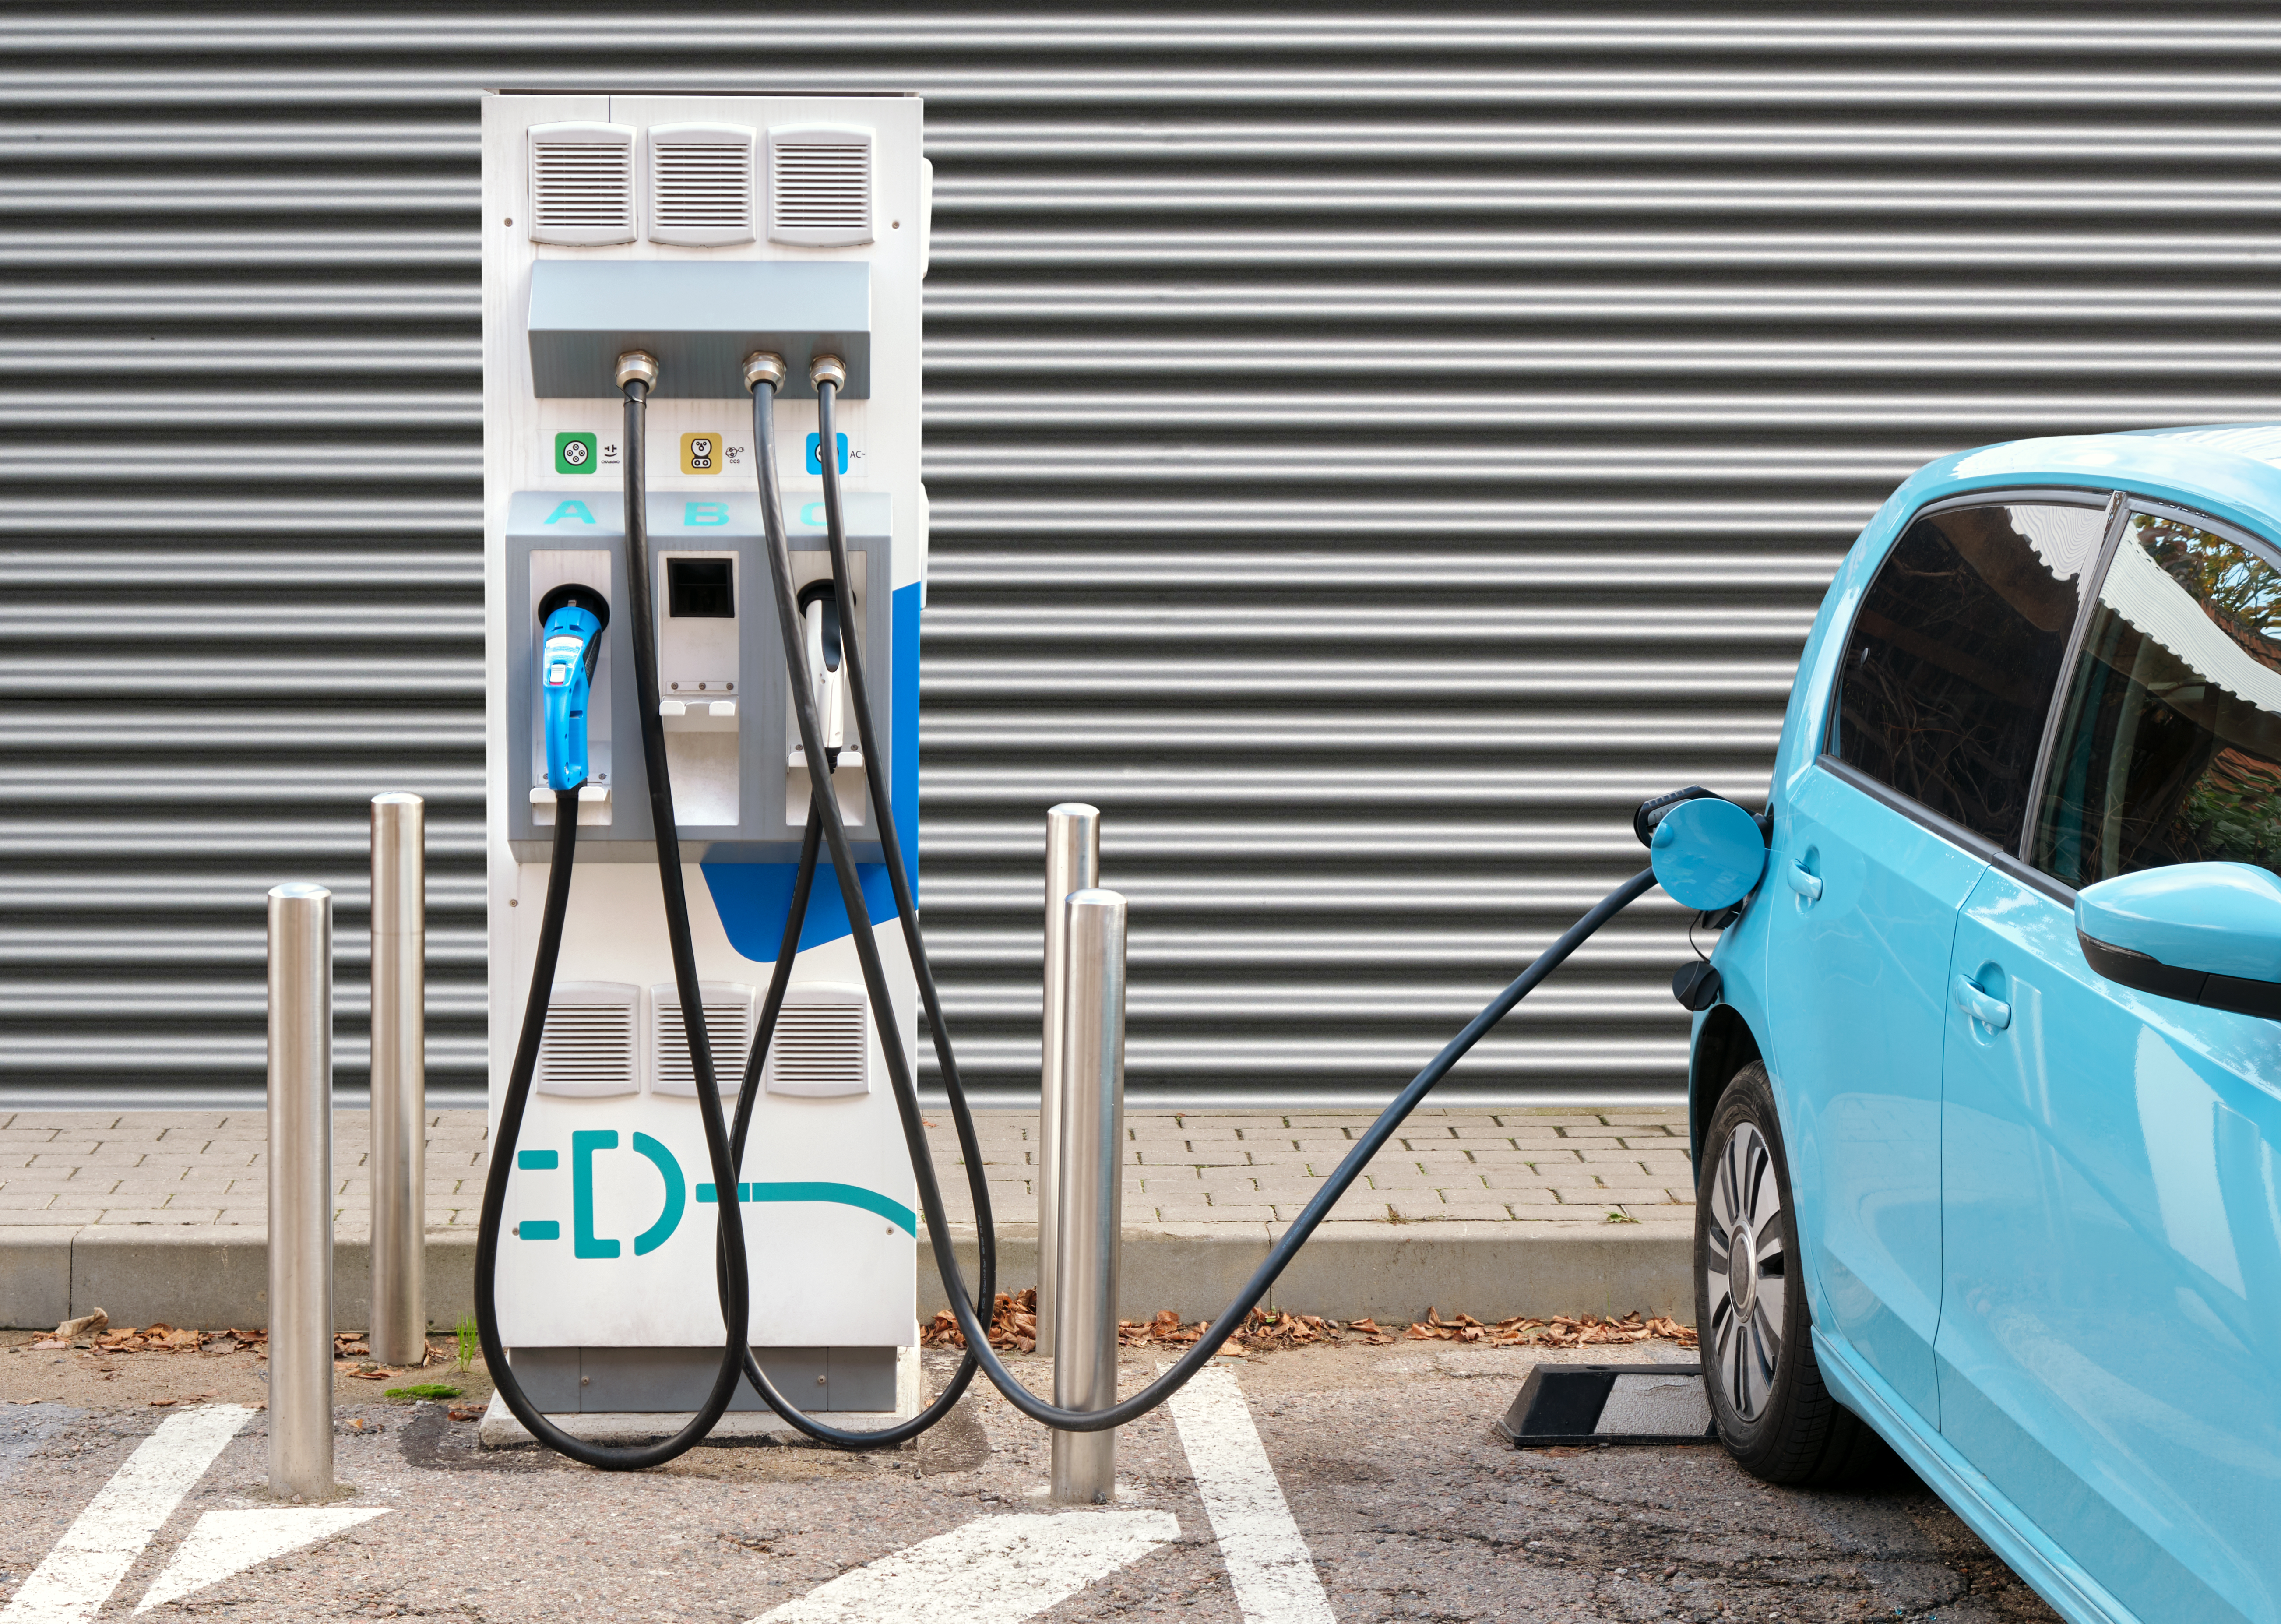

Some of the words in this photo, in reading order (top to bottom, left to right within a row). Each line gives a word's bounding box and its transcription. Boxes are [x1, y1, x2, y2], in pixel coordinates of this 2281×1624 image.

[543, 500, 597, 525] A
[683, 502, 729, 526] B
[800, 502, 827, 526] C
